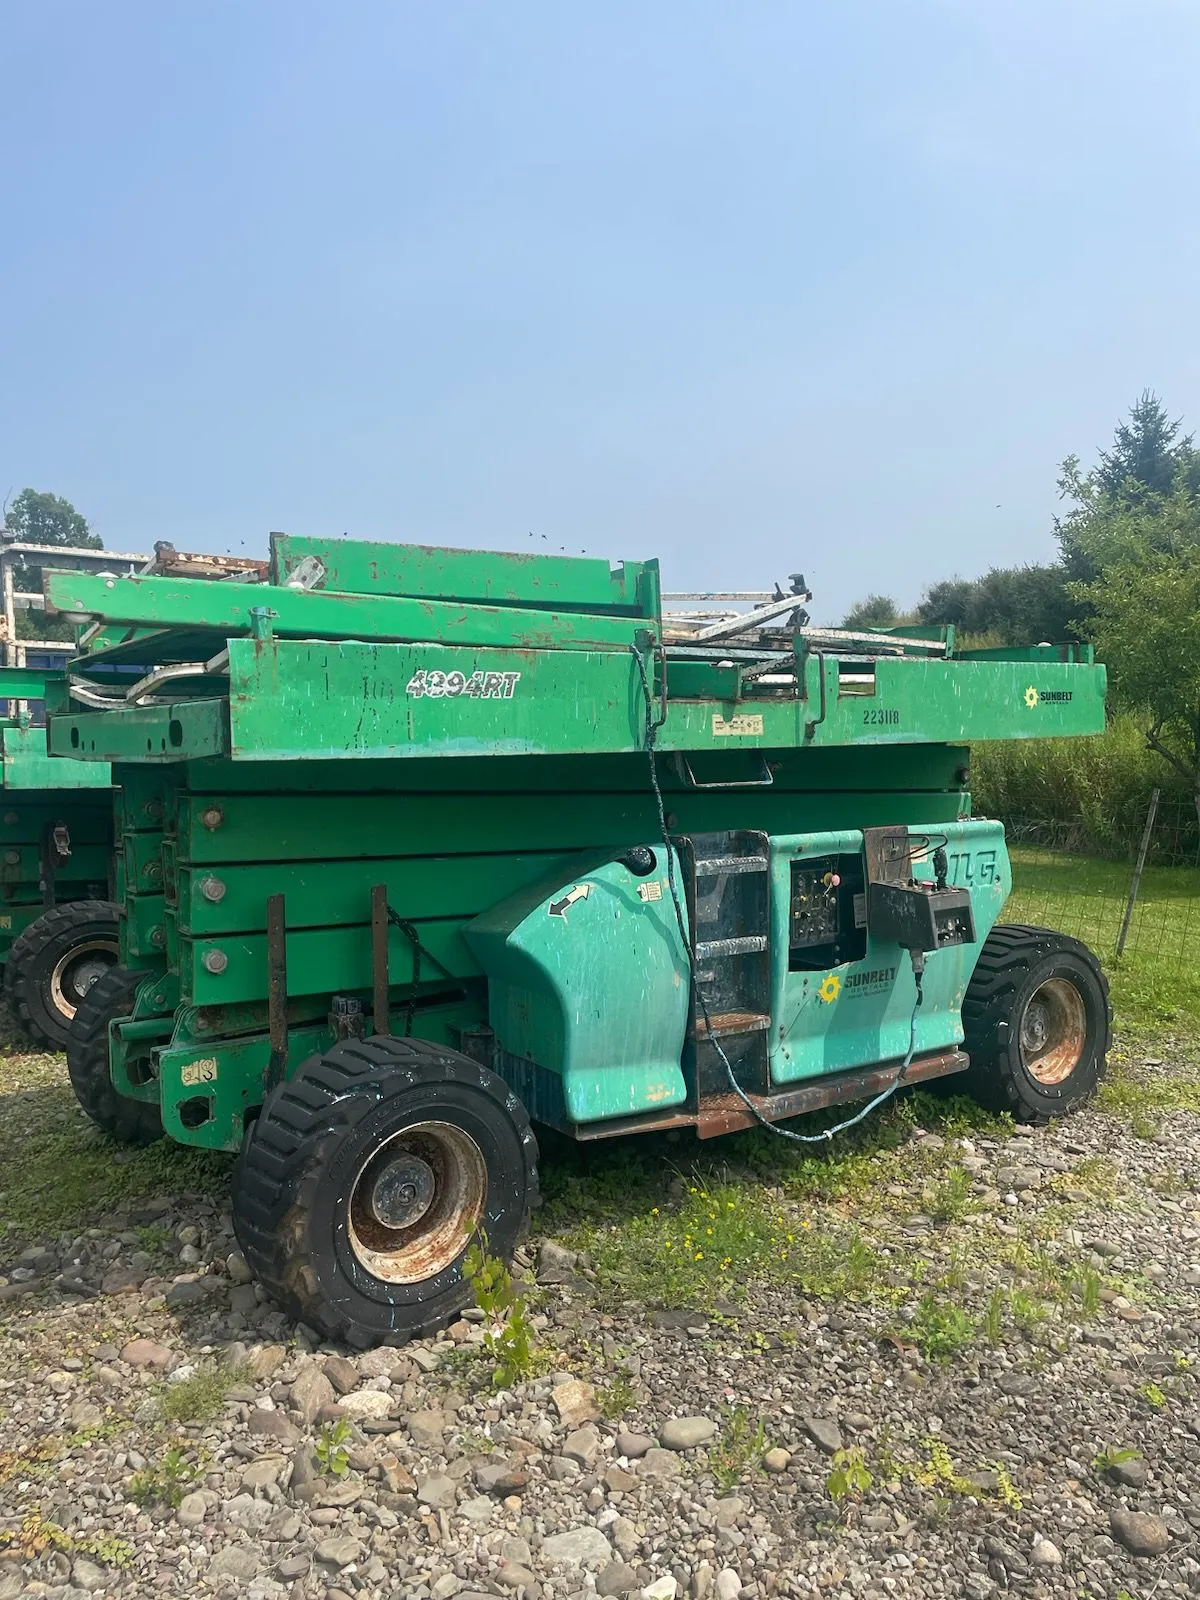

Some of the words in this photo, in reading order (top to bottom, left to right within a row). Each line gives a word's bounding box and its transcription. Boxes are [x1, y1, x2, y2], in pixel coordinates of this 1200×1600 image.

[406, 669, 521, 699] 4394RT
[1040, 691, 1073, 701] SUNBELT
[863, 709, 899, 725] 223118
[844, 967, 896, 988] SUNBELT
